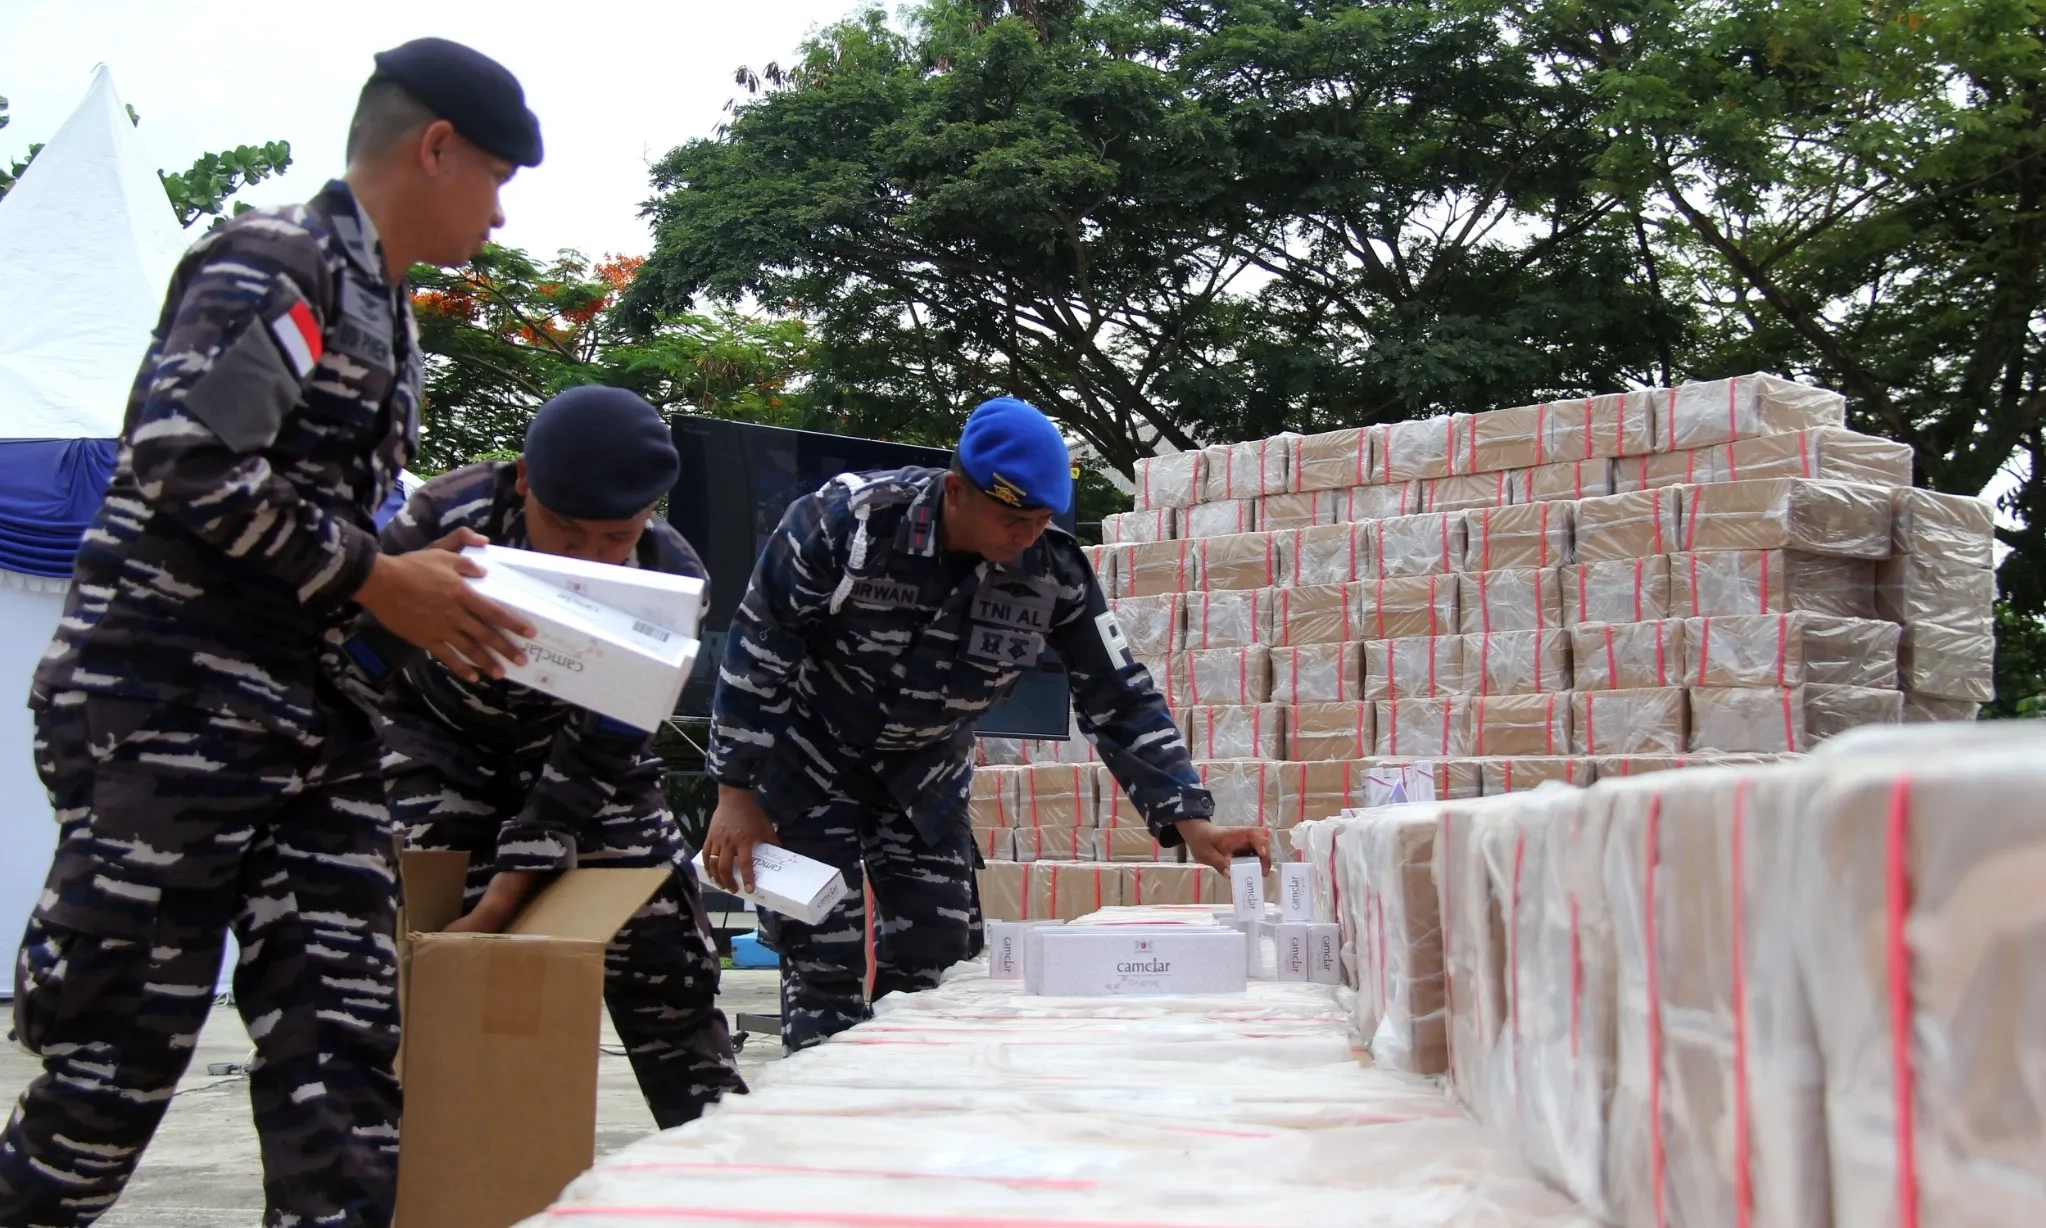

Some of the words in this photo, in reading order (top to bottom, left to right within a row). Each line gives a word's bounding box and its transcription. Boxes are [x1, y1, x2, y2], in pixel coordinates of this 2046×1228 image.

[851, 582, 915, 605] IRWAN
[980, 600, 1011, 621] TNI
[1016, 608, 1042, 627] AL
[1246, 876, 1258, 910] camclar
[1289, 876, 1299, 910] camclar
[1004, 936, 1014, 973] camclar
[1116, 957, 1171, 974] camclar
[1292, 937, 1302, 973] camclar
[1323, 935, 1333, 971] camclar
